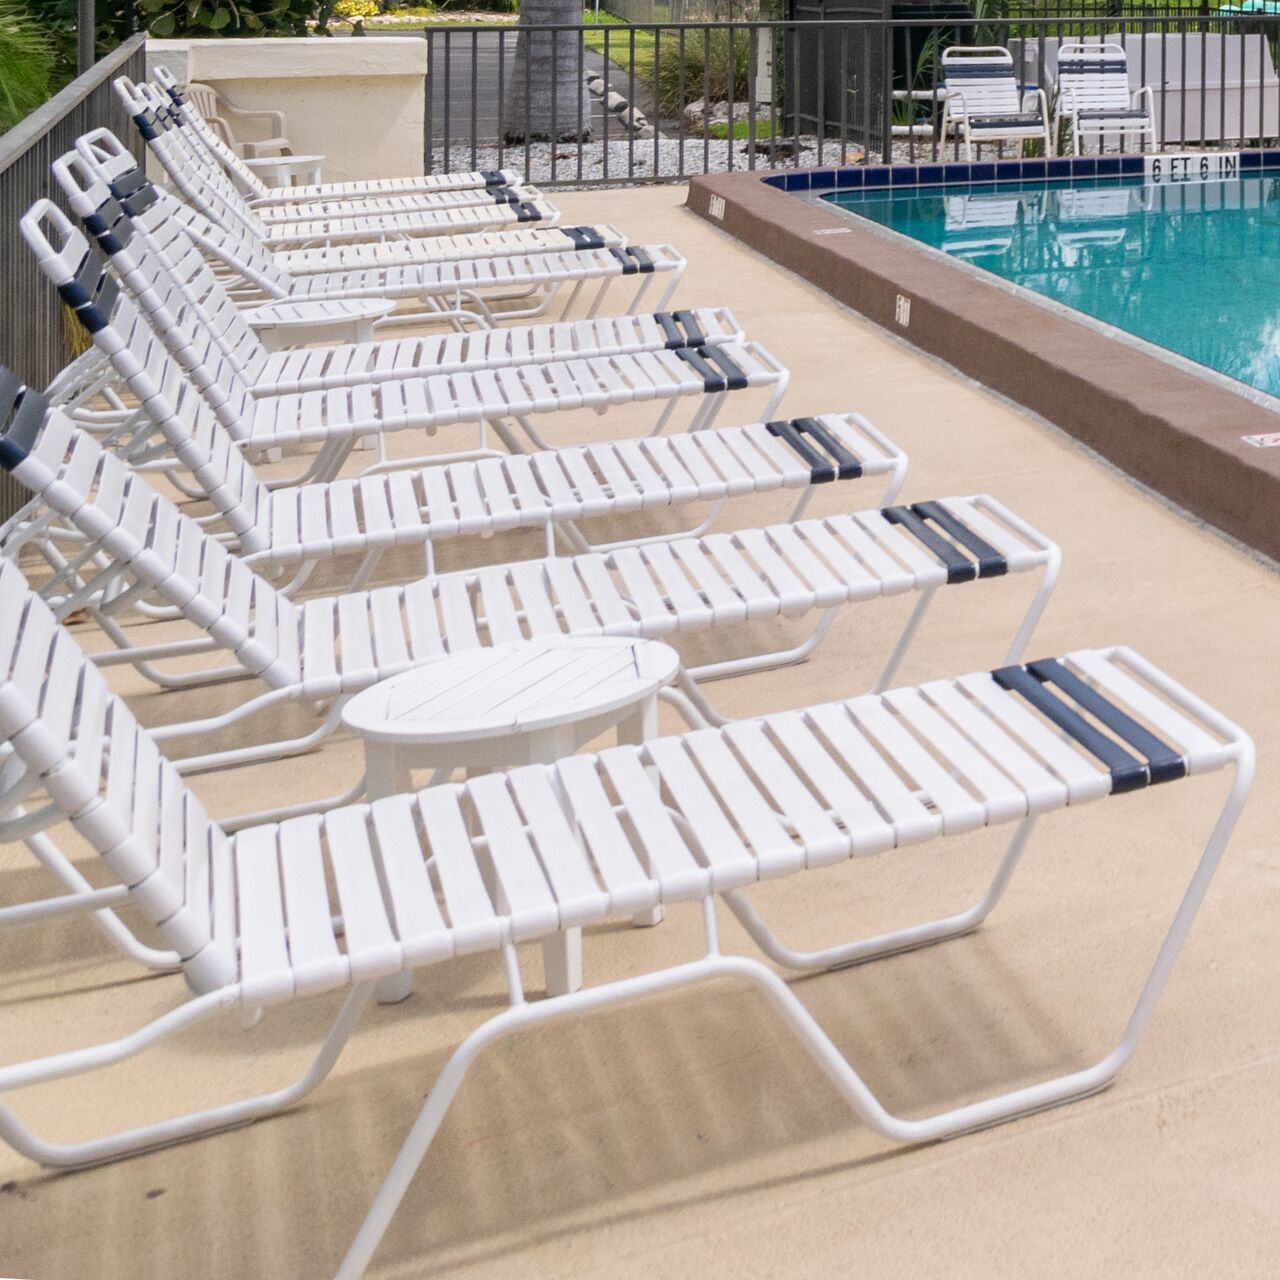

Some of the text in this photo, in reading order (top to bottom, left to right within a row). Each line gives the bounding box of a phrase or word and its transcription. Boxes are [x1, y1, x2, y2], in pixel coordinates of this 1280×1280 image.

[1152, 155, 1237, 175] 6 FT 6 IN
